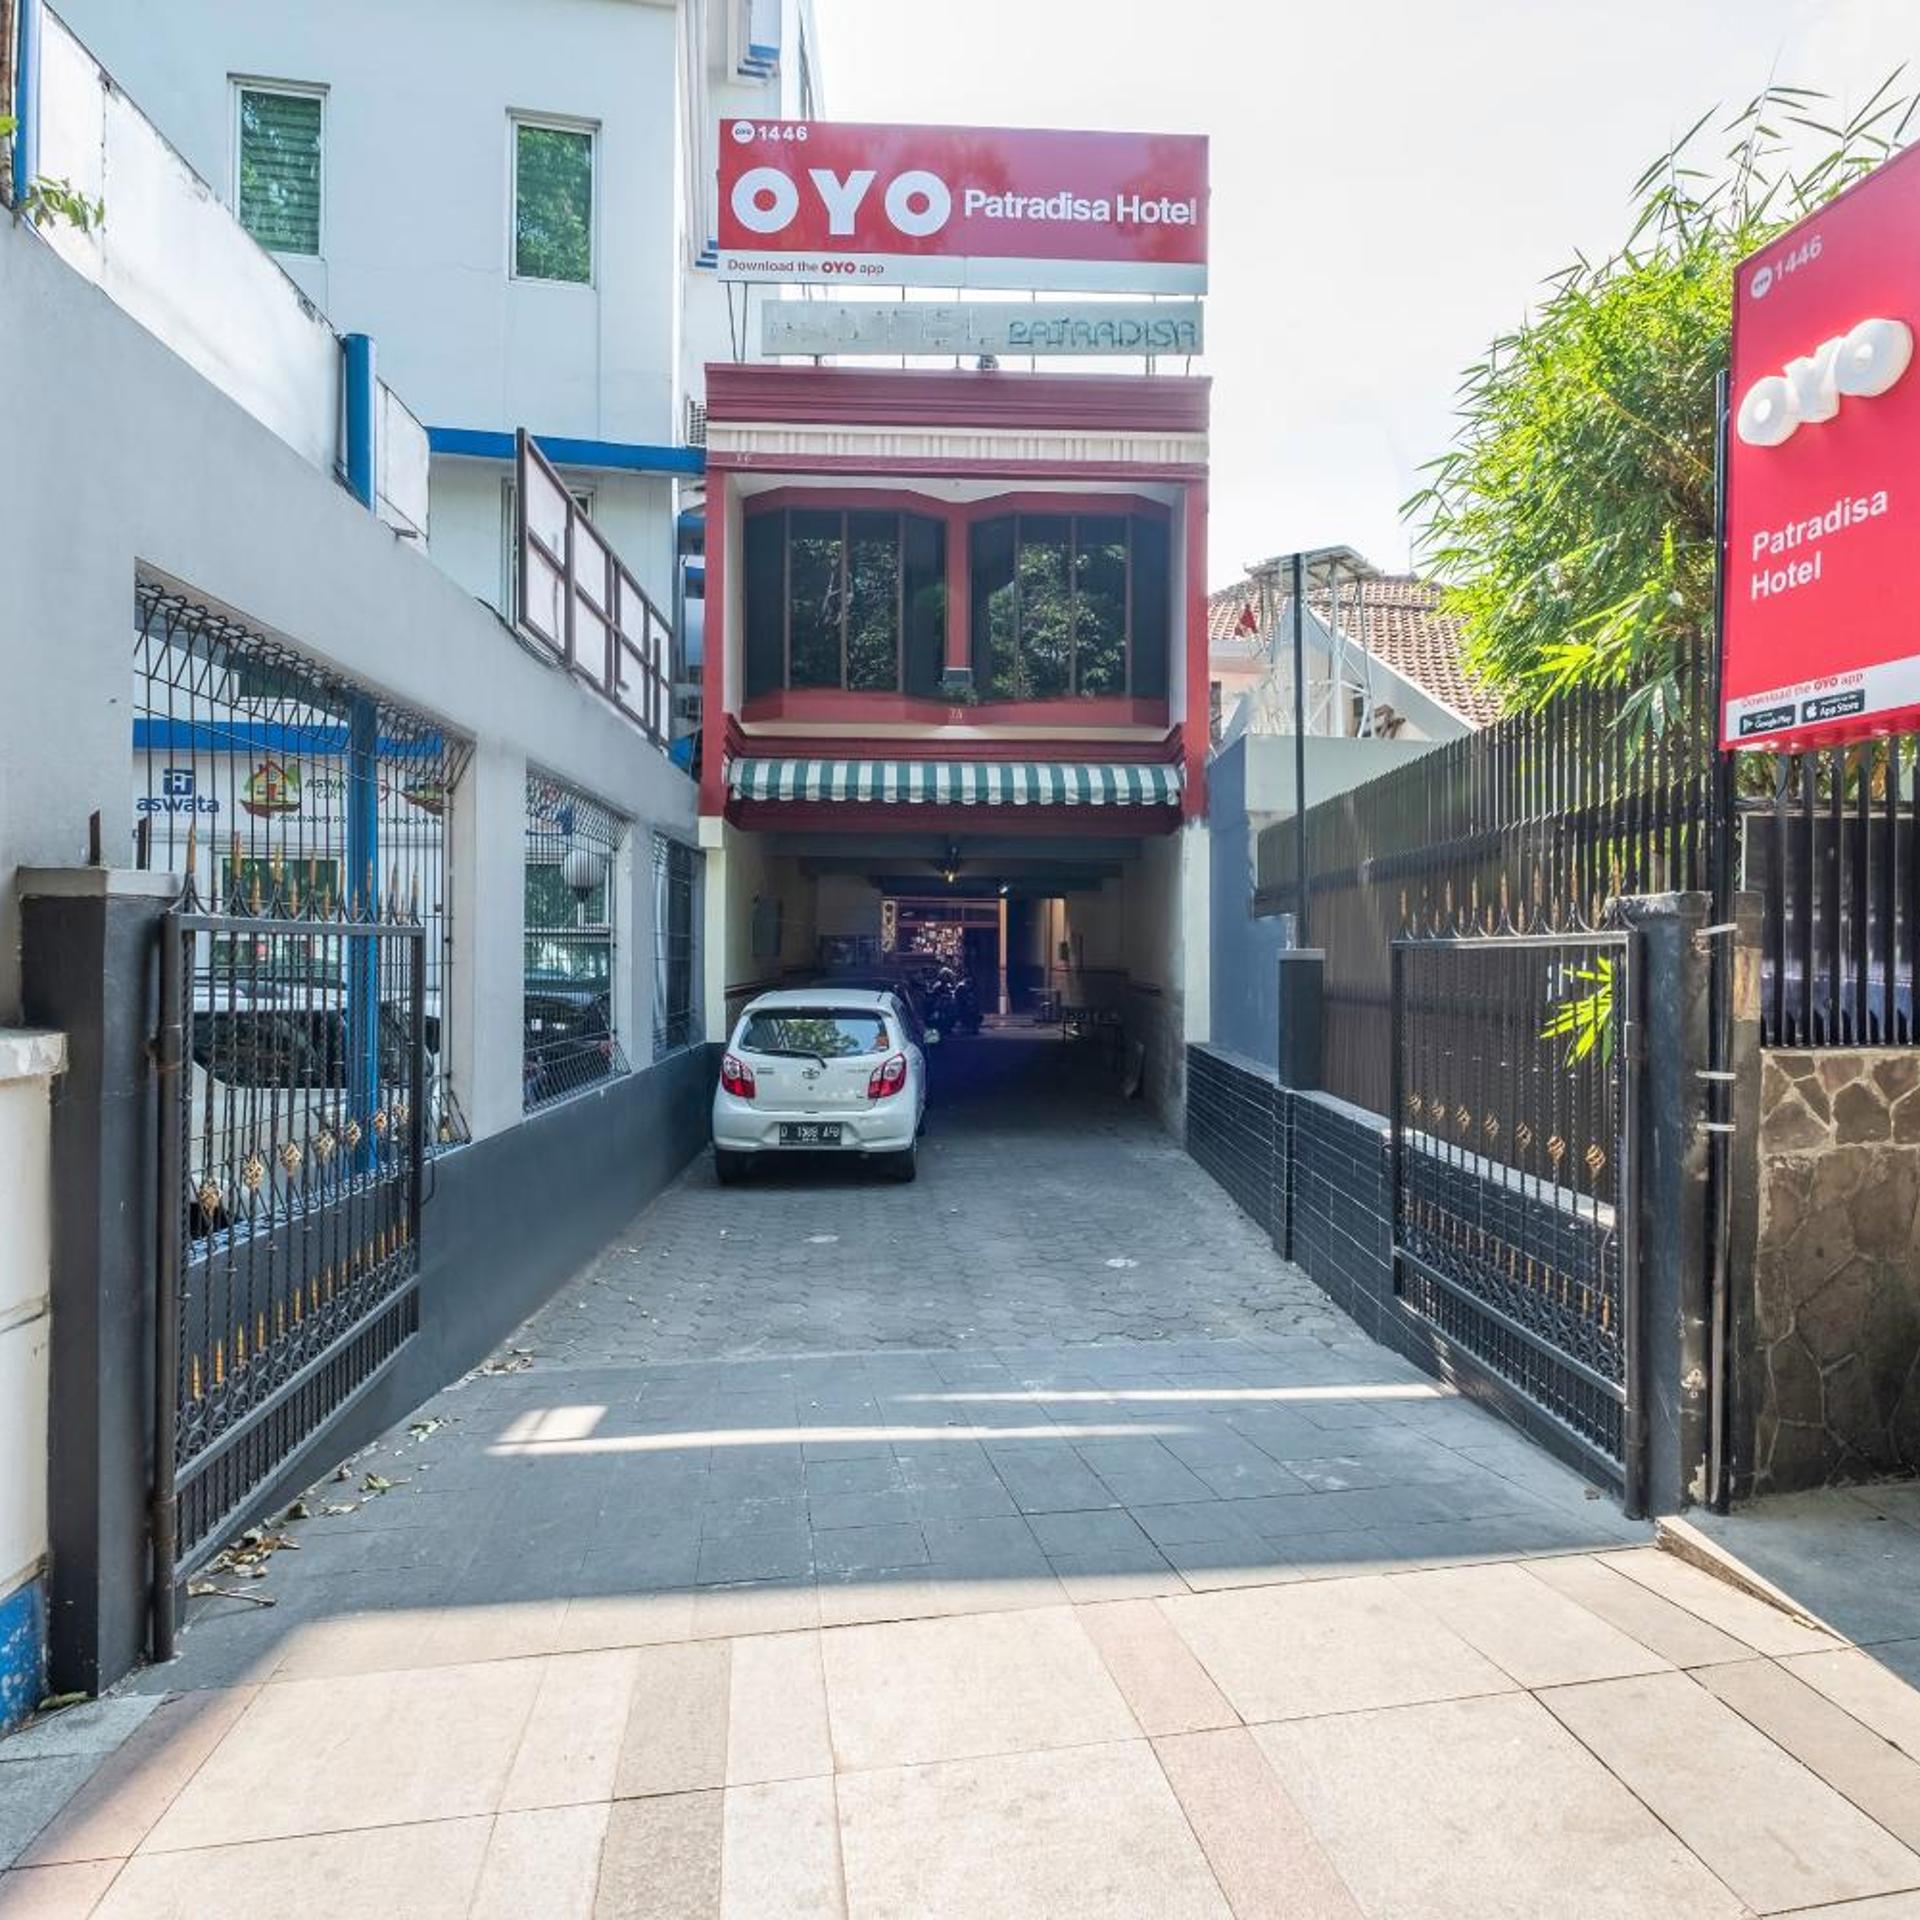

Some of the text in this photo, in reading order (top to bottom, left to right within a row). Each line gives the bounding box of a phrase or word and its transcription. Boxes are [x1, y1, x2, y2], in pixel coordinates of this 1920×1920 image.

[759, 126, 808, 141] 1446
[731, 167, 1197, 237] OYO Patradisa Hotel
[727, 258, 885, 277] Download the OYO app
[1774, 235, 1823, 281] 1446
[1752, 490, 1888, 562] Patradisa
[1751, 550, 1822, 601] Hotel
[1813, 676, 1839, 691] OYO
[1819, 705, 1836, 719] App
[135, 794, 220, 814] aswata
